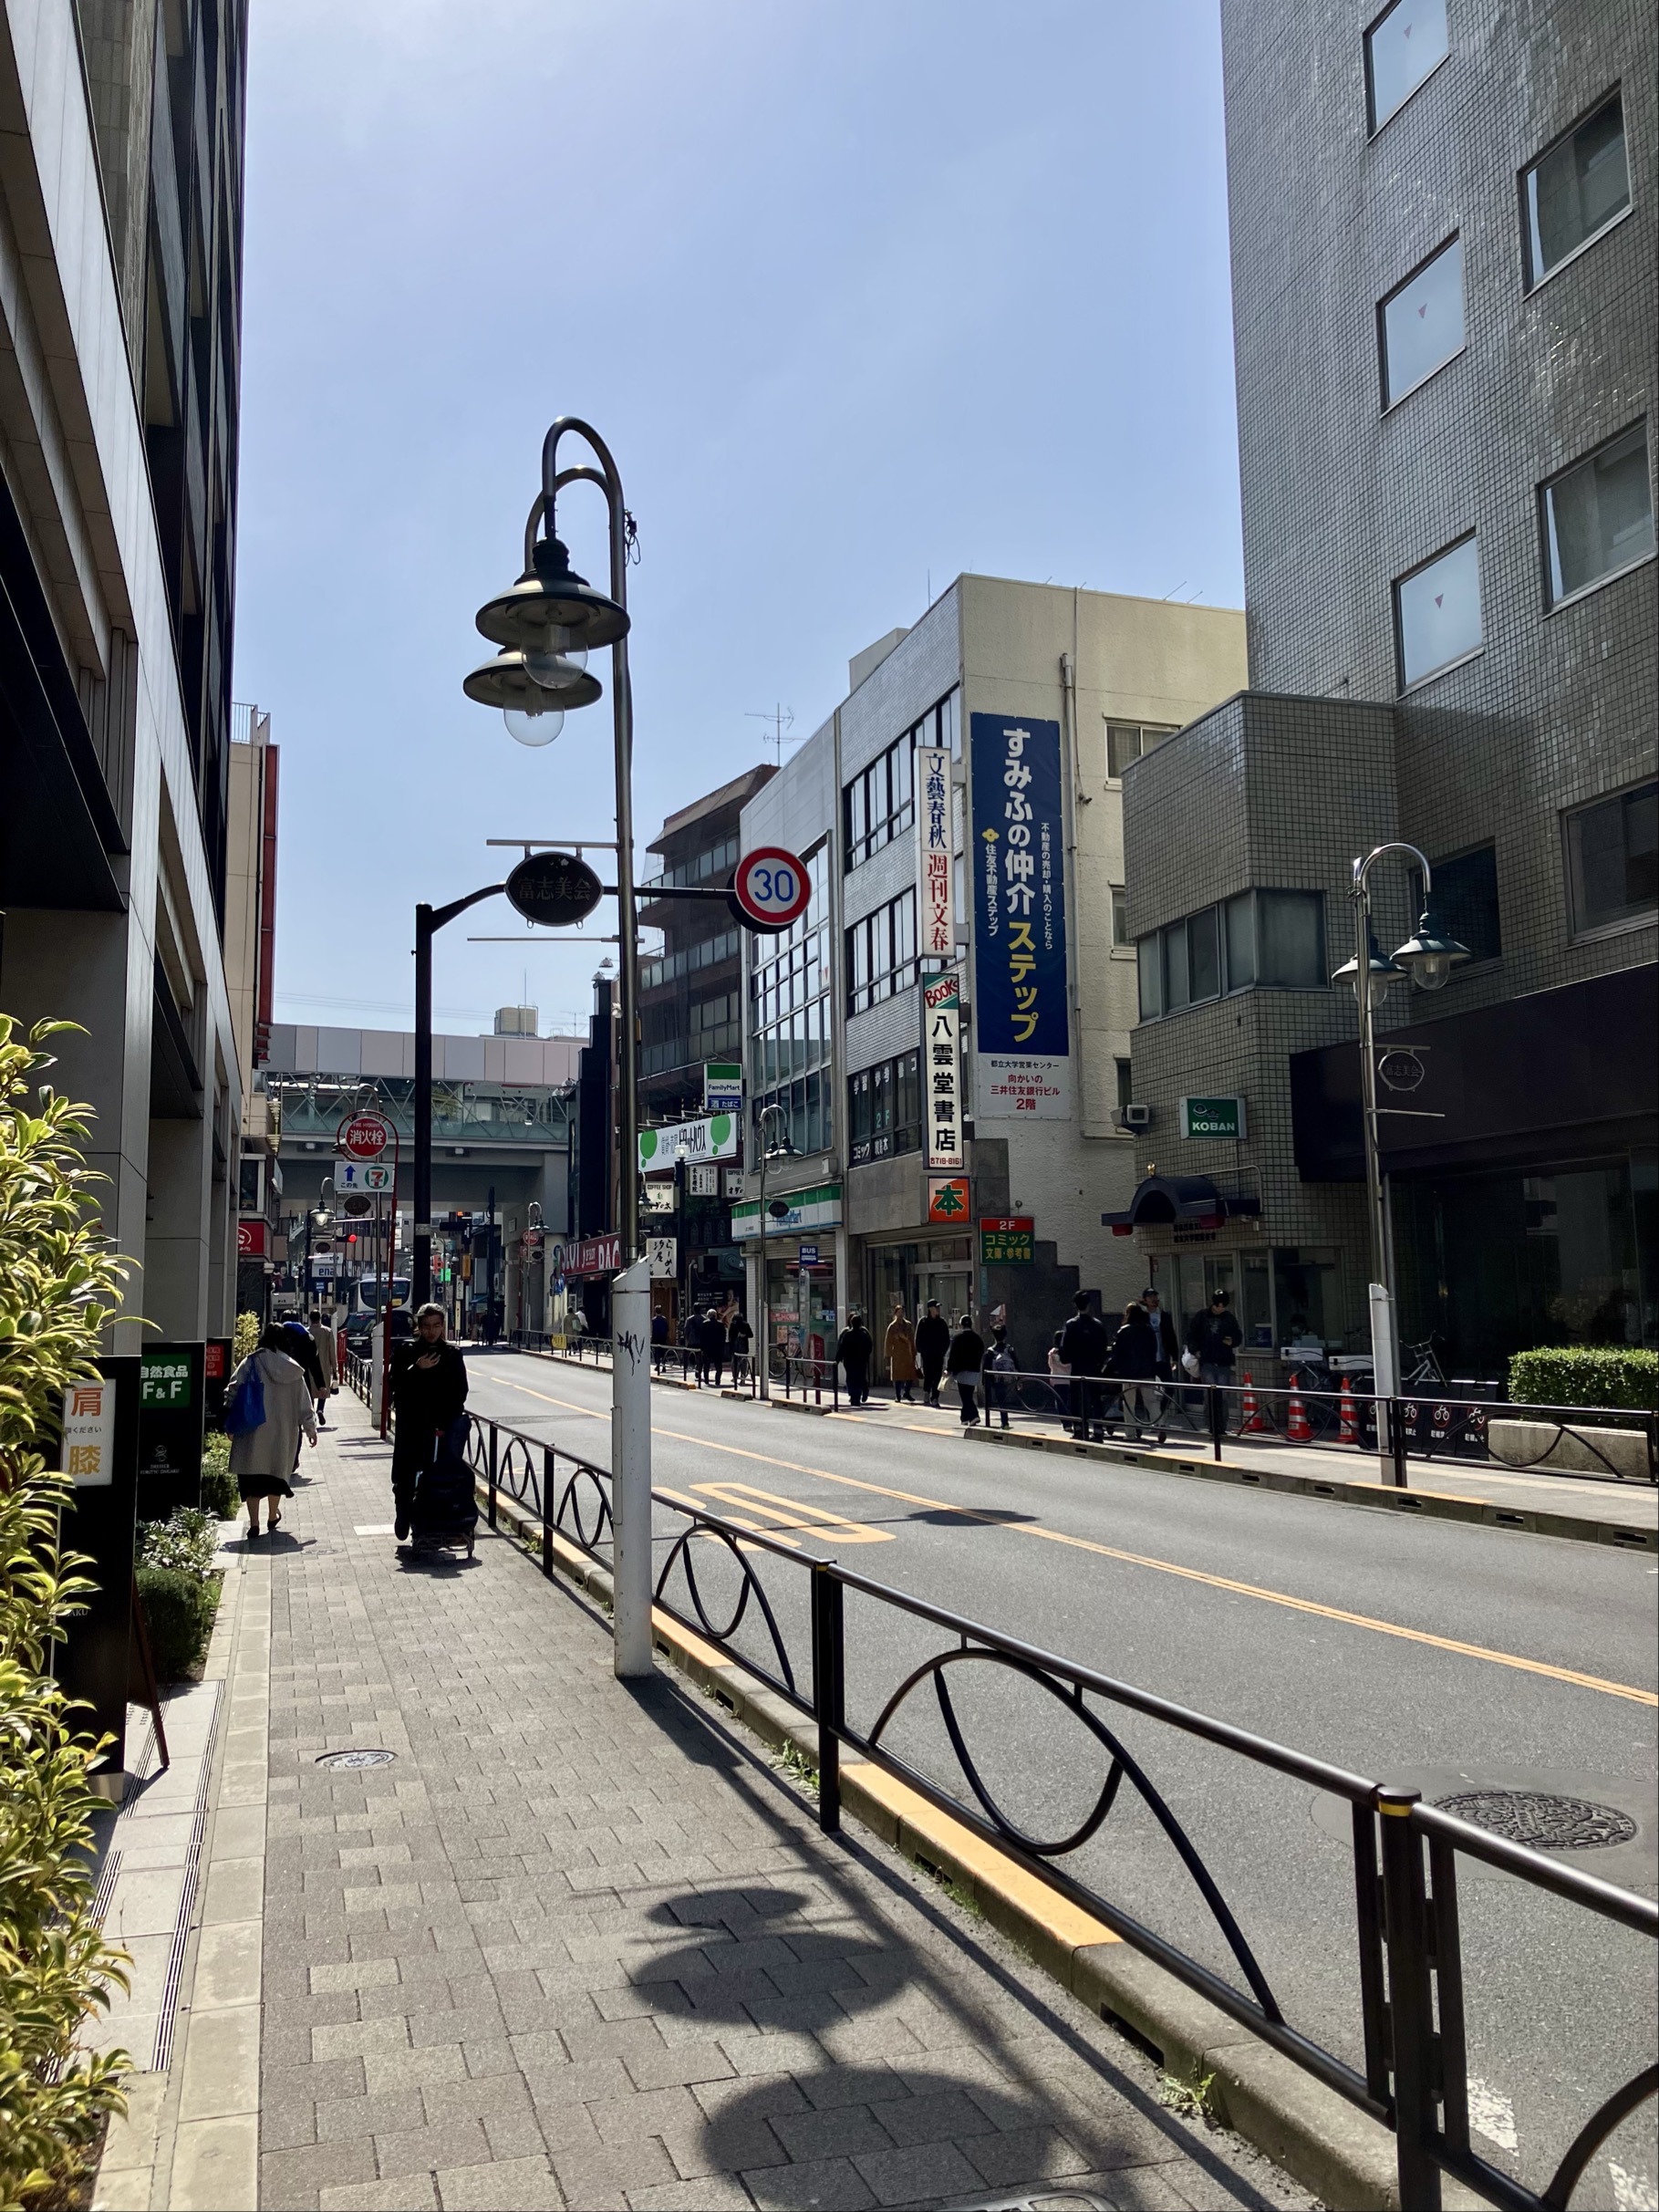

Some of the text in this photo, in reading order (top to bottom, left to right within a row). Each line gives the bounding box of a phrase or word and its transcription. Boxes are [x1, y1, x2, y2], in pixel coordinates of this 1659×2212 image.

[925, 753, 948, 849] 文藝春秋
[754, 868, 794, 902] 30
[985, 844, 1000, 937] 住友不動産ステップ
[1002, 728, 1039, 1043] すみふの仲介ステップ
[927, 854, 949, 951] 週刊文春
[990, 1060, 1059, 1070] 都立大学営業センター
[708, 1084, 741, 1092] FamilyMart
[931, 1015, 956, 1151] 八雲堂書店
[1008, 1075, 1043, 1084] 向かいの
[990, 1085, 1061, 1096] 三井住友銀行ビル
[1016, 1098, 1036, 1110] 2階
[1192, 1122, 1236, 1131] KOBAN
[349, 1129, 384, 1146] 消火栓
[934, 1184, 965, 1216] 本
[1000, 1220, 1016, 1231] 2F
[985, 1234, 1030, 1246] コミック
[140, 1365, 189, 1378] 自然食品
[71, 1387, 104, 1417] 肩
[67, 1445, 101, 1476] 膝
